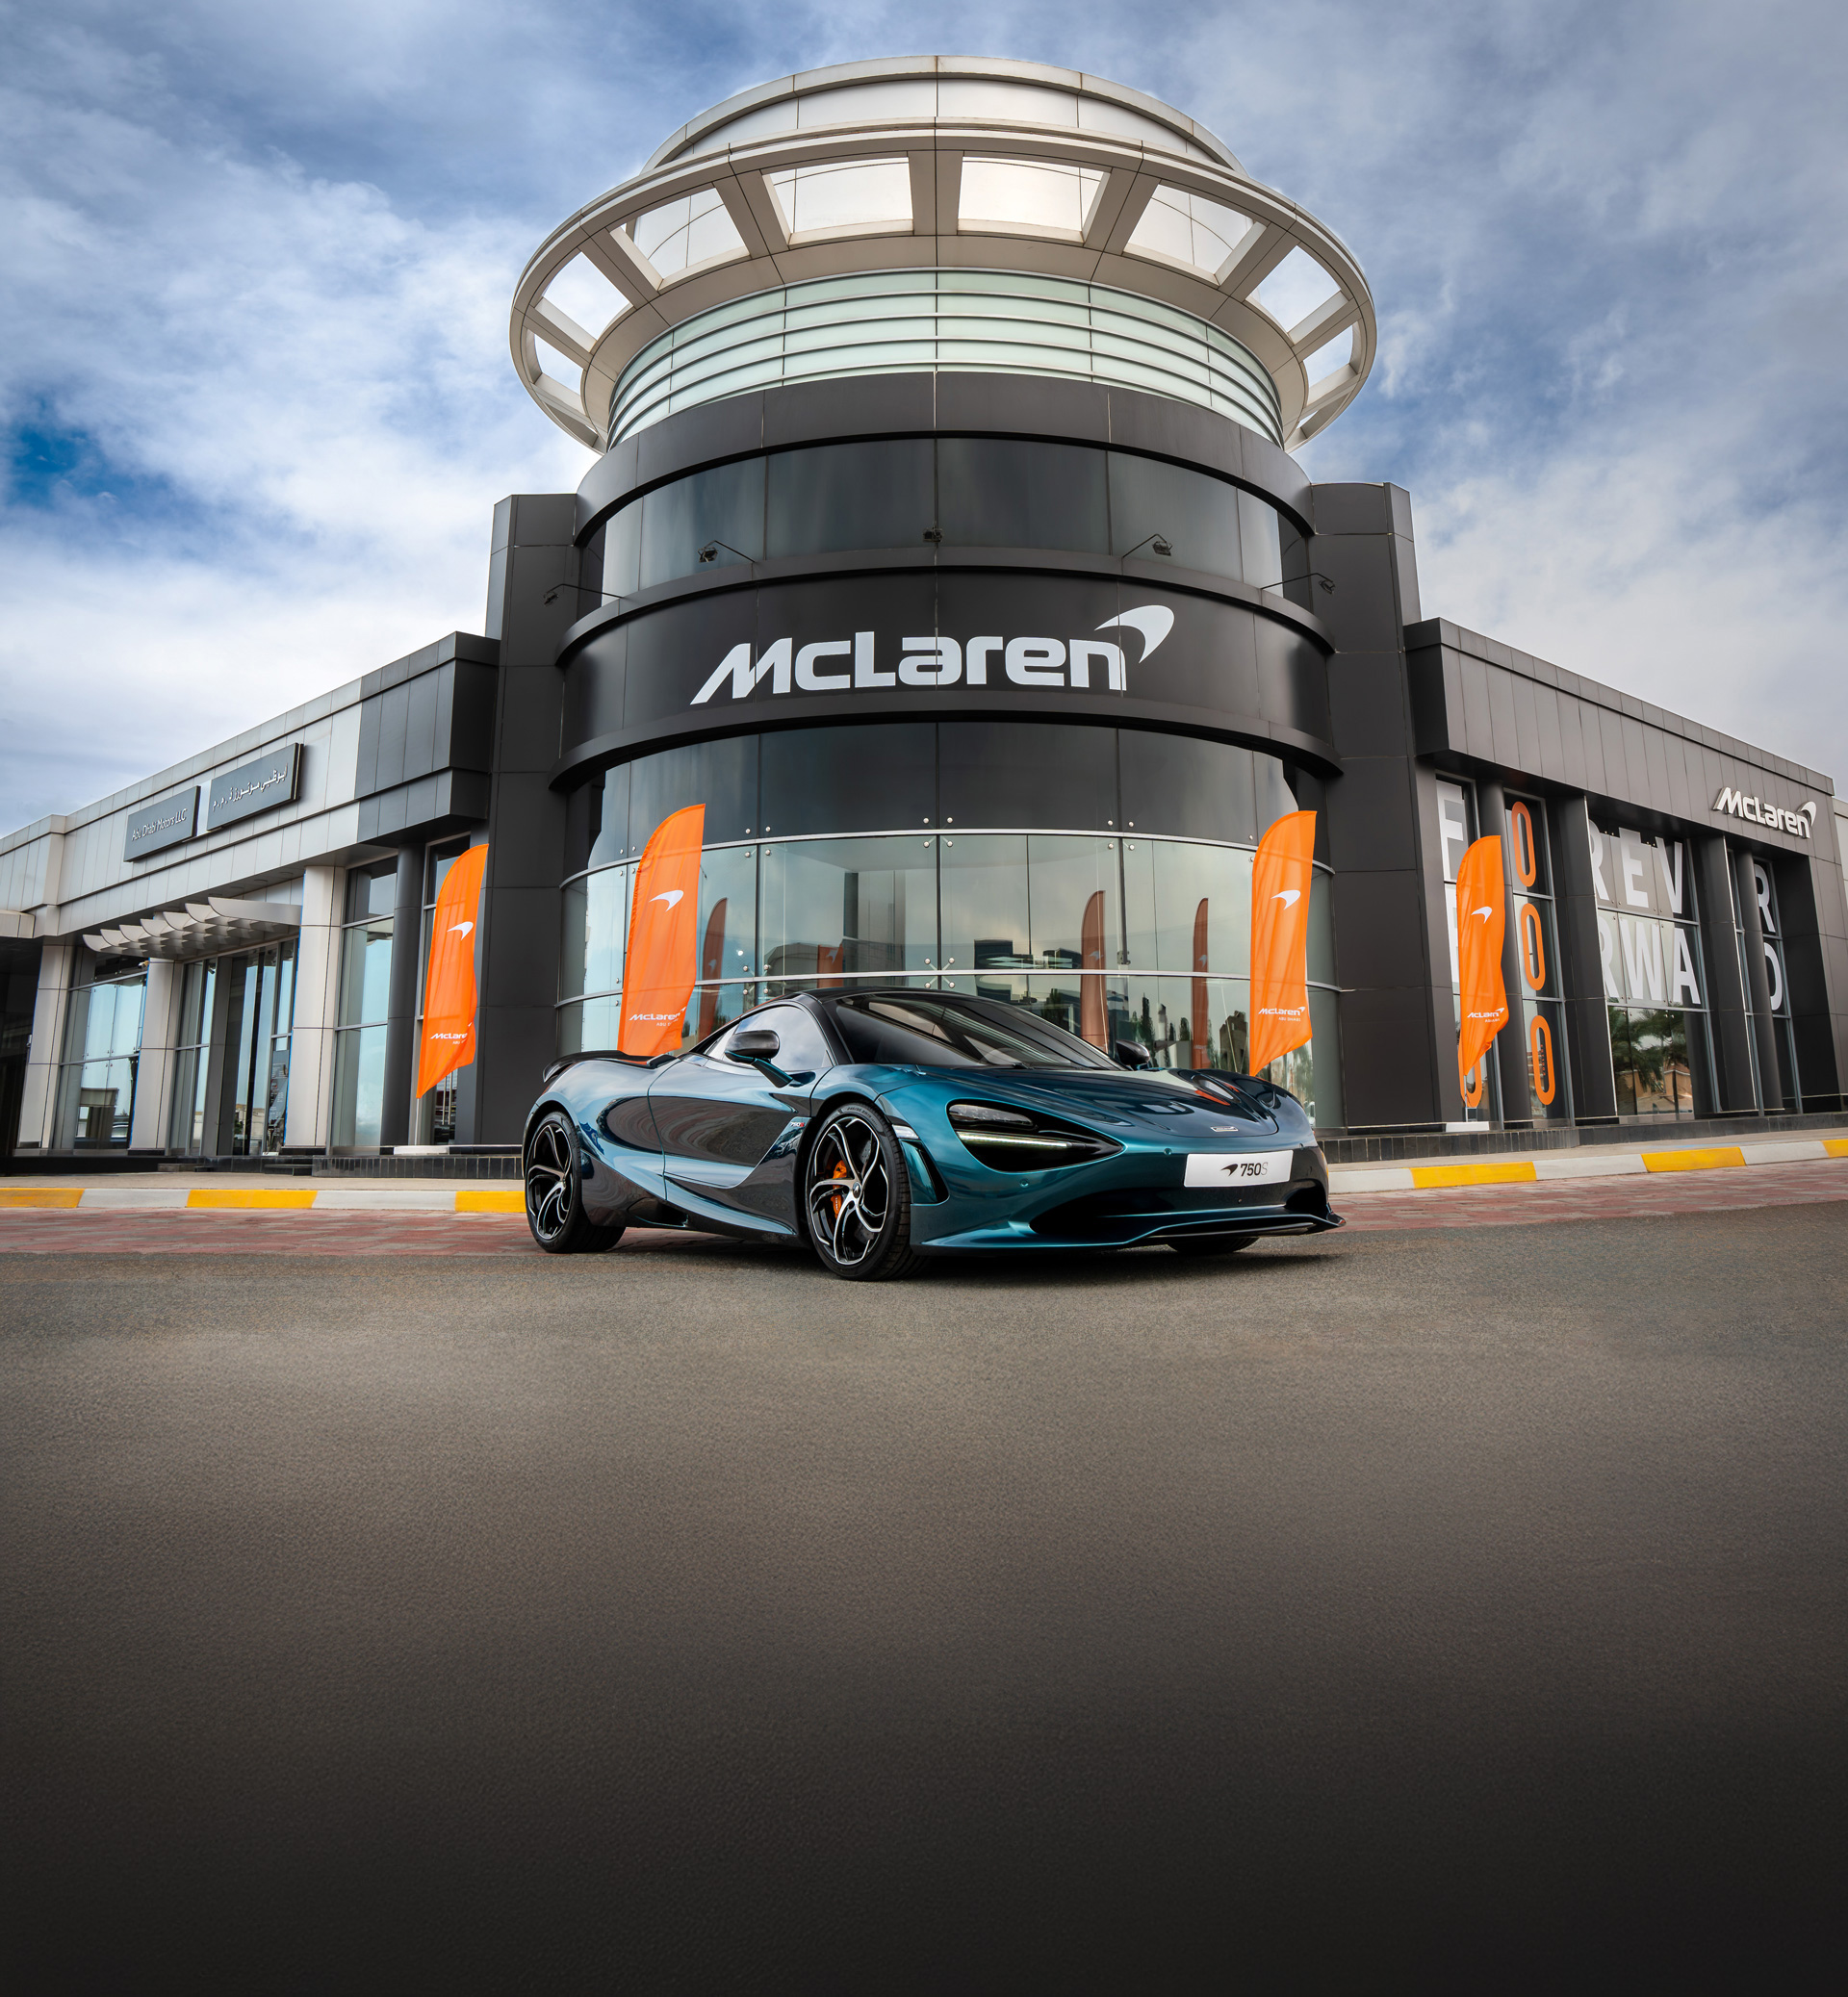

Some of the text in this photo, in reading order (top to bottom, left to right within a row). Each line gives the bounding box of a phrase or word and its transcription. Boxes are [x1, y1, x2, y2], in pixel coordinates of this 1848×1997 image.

[689, 630, 1128, 705] McLaren
[132, 807, 187, 841] Abu Dhabi Motors LLC
[1712, 786, 1810, 839] McLaren
[628, 1012, 680, 1021] McLare
[1258, 1008, 1301, 1016] McLaren
[1240, 1162, 1269, 1177] 750S
